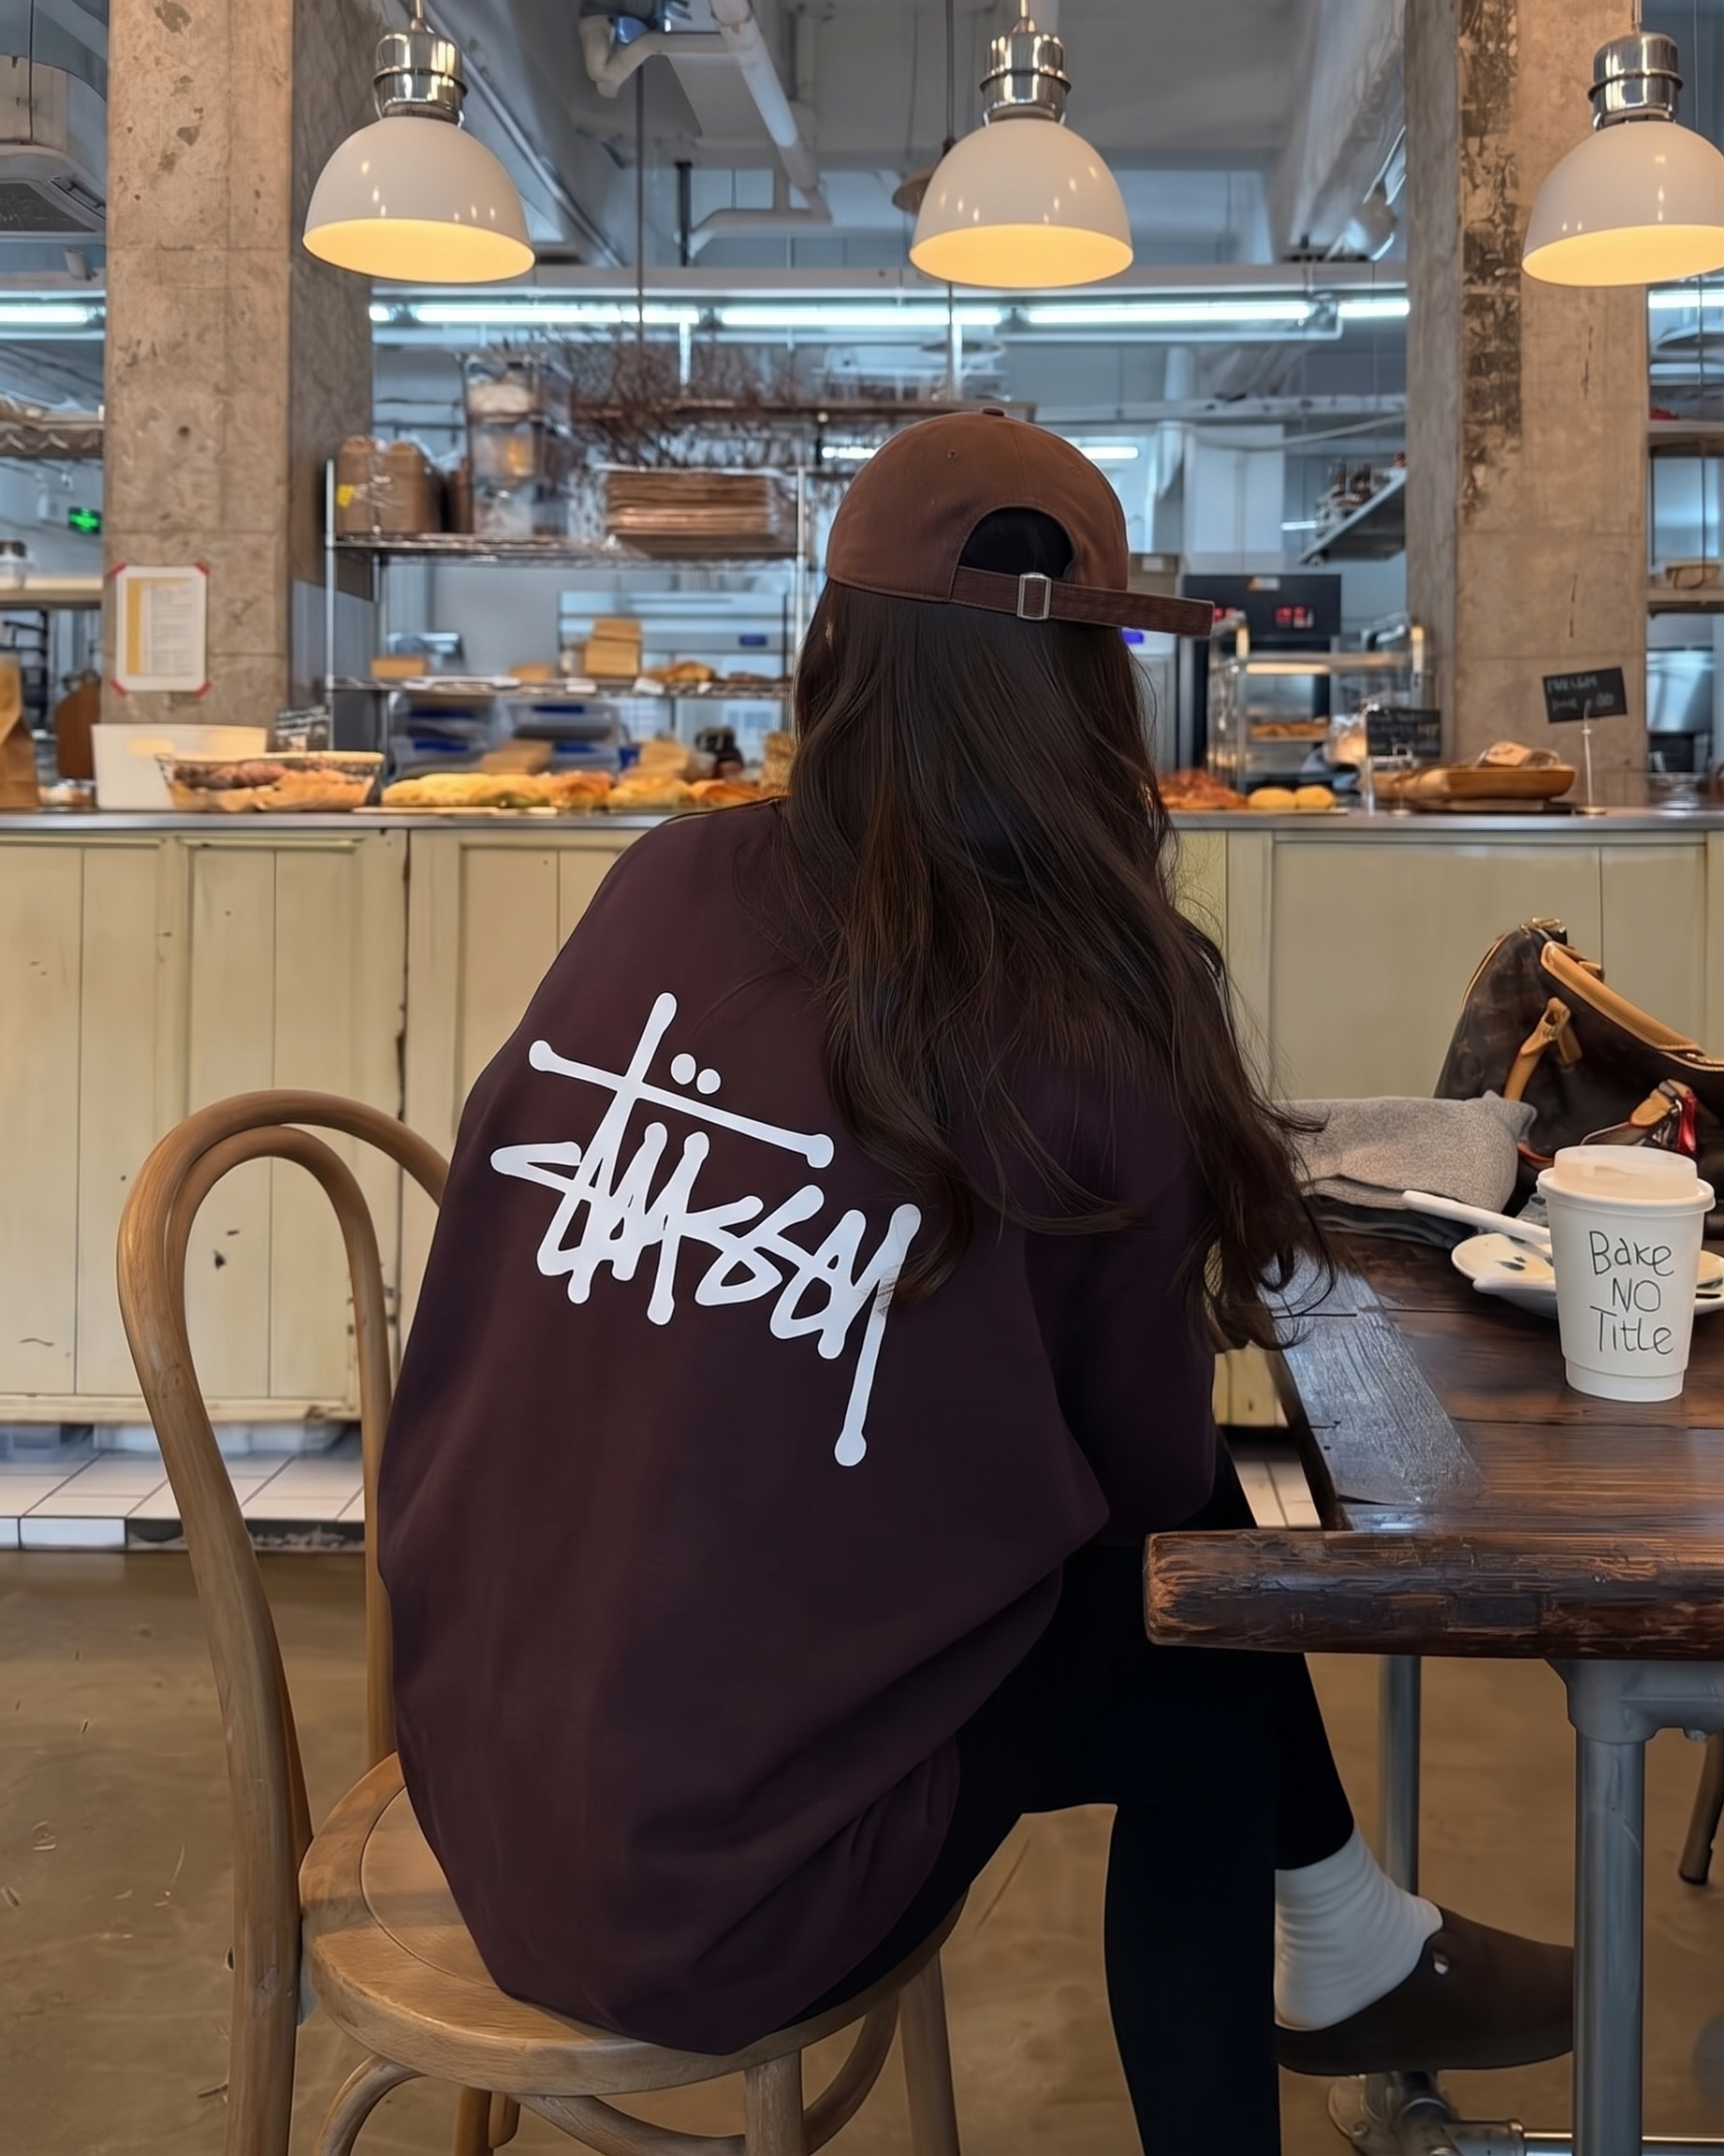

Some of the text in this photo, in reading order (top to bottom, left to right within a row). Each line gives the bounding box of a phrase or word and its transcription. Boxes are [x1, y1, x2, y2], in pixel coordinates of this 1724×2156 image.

[1589, 1231, 1674, 1276] Bake
[1612, 1277, 1661, 1312] NO
[1589, 1305, 1673, 1355] Title
